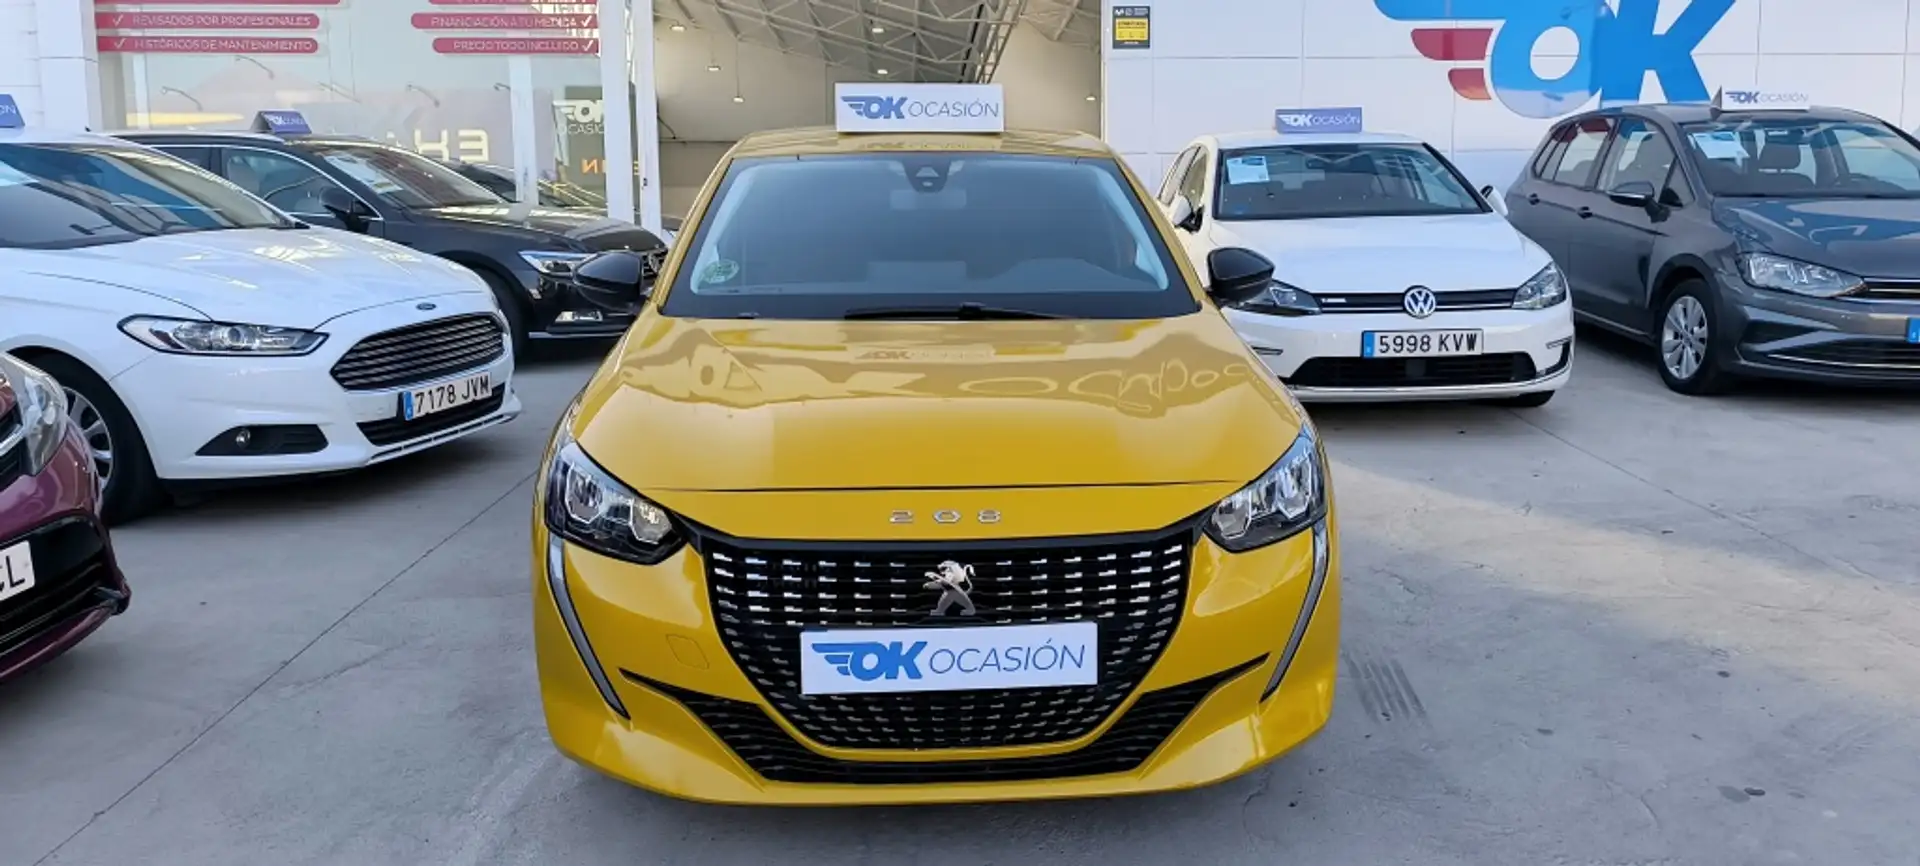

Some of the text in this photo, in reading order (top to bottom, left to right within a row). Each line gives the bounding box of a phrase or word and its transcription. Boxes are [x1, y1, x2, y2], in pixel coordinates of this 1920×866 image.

[132, 16, 311, 26] REVISADOS POR PROFESIONALES
[431, 16, 508, 27] FINANCIACIÓN
[134, 38, 313, 51] HISTÓRICOS DE MANTENIMIENTO
[453, 41, 493, 51] PRECIO
[527, 41, 579, 51] INCLUIDO
[908, 98, 999, 118] OCASIÓN
[1312, 112, 1361, 126] OCASIÓN
[1379, 332, 1478, 354] 5998 KVW
[415, 375, 490, 414] 7178 JVM
[889, 509, 1001, 523] 208
[849, 638, 1086, 681] OK OCASIÓN
